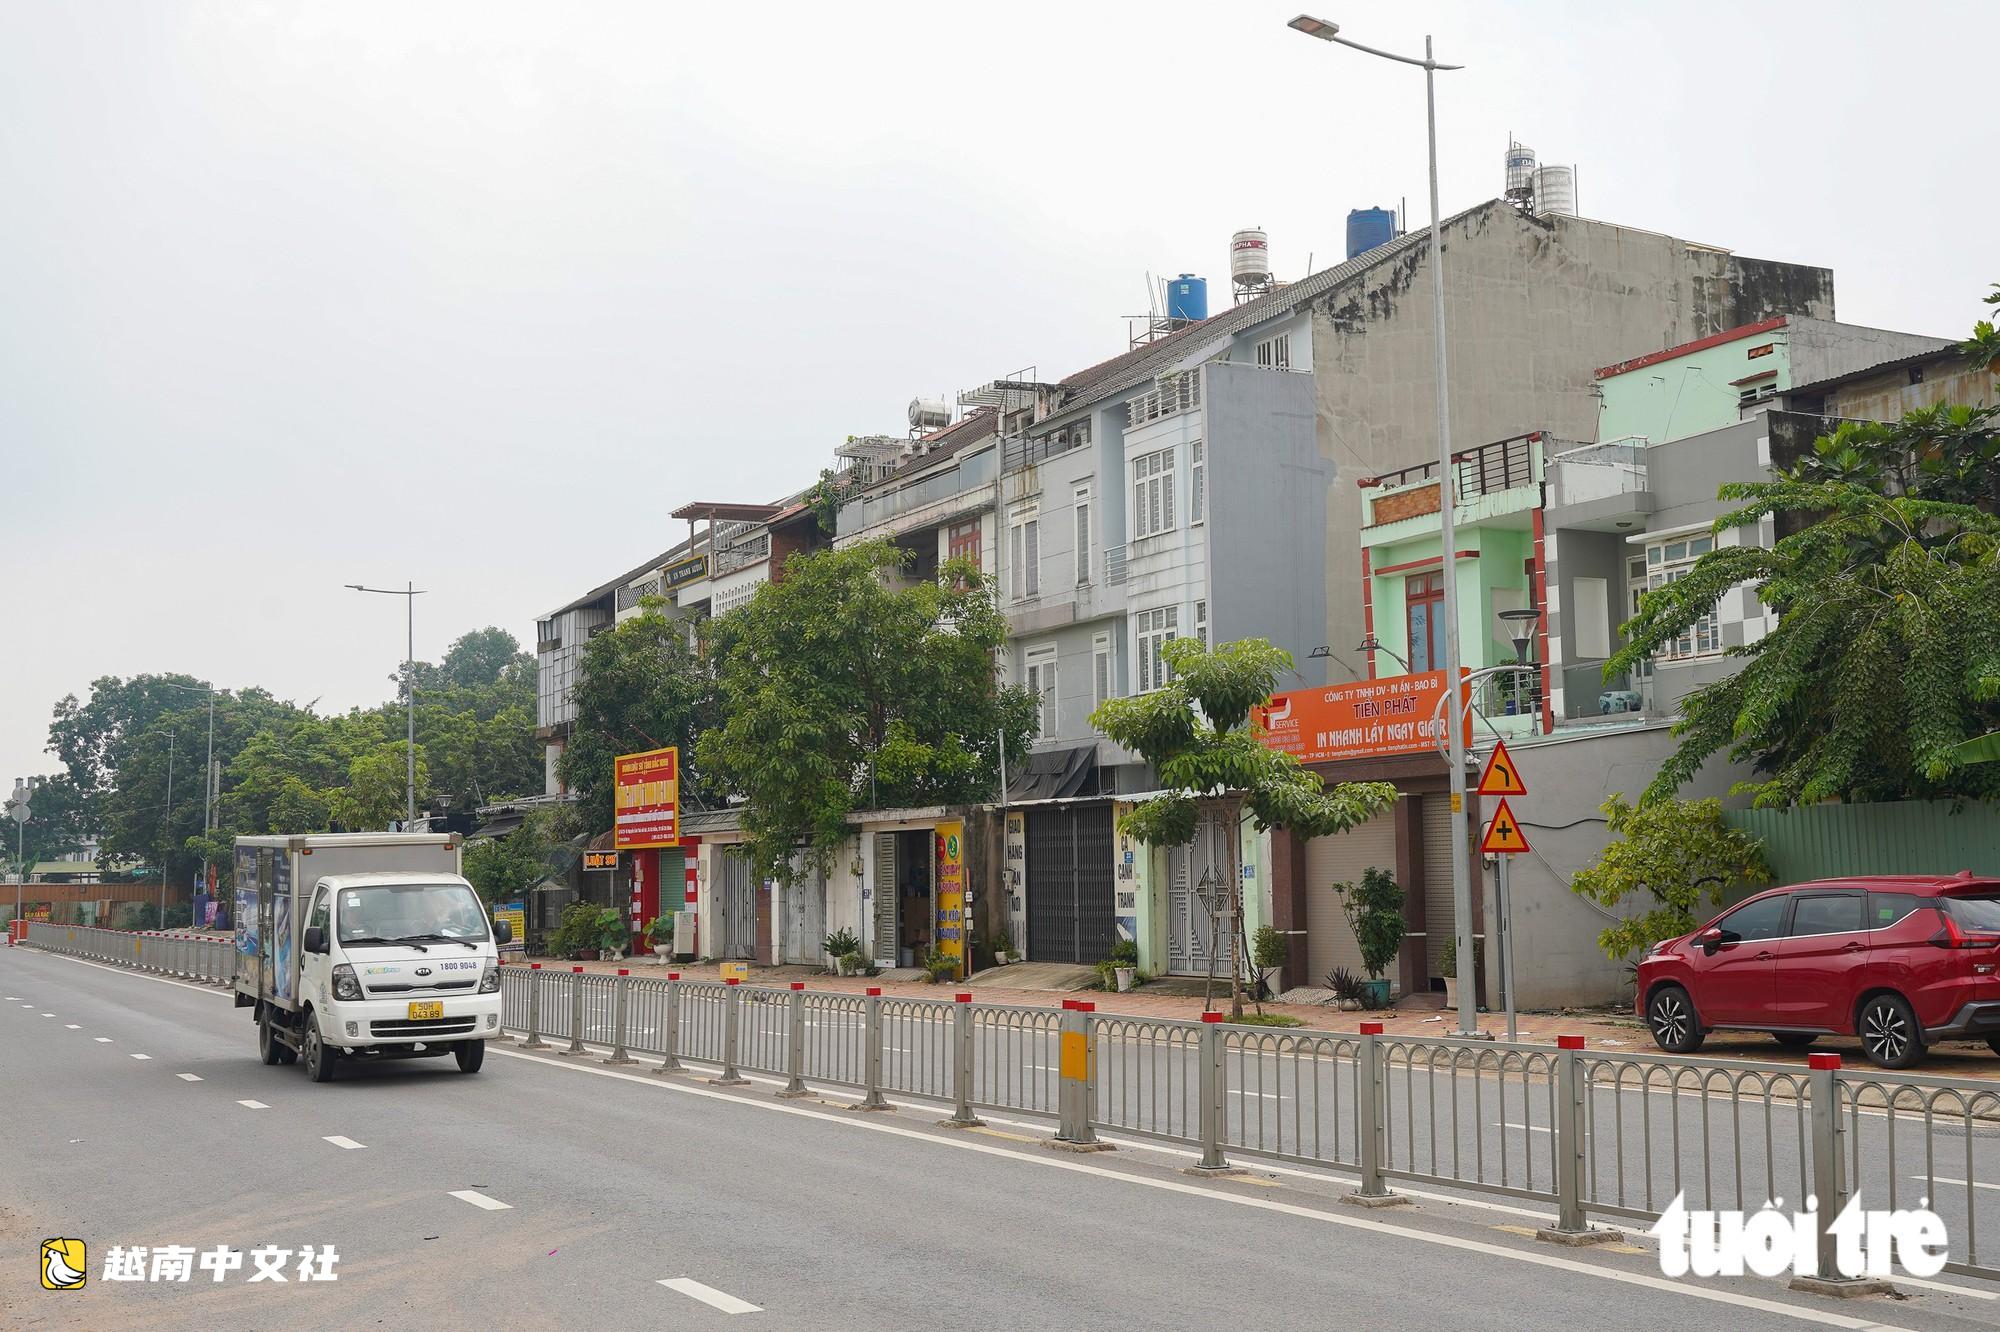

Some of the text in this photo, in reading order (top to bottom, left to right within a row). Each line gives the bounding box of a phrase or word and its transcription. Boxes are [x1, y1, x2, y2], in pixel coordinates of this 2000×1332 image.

[1324, 690, 1344, 703] CÔNG
[1344, 690, 1354, 700] TY
[1356, 687, 1375, 699] TNHH
[1376, 685, 1386, 695] DV
[1390, 683, 1398, 694] IN
[1414, 680, 1429, 691] BAO
[1275, 718, 1299, 729] SERVICE
[1317, 731, 1327, 748] IN
[1329, 727, 1363, 747] NHANH
[1365, 720, 1384, 744] LẤY
[1387, 721, 1414, 740] NGAY
[1009, 819, 1021, 834] GIAO
[1008, 842, 1023, 859] HÀNG
[586, 853, 605, 868] LUẬT
[440, 961, 477, 970] 1800 9048
